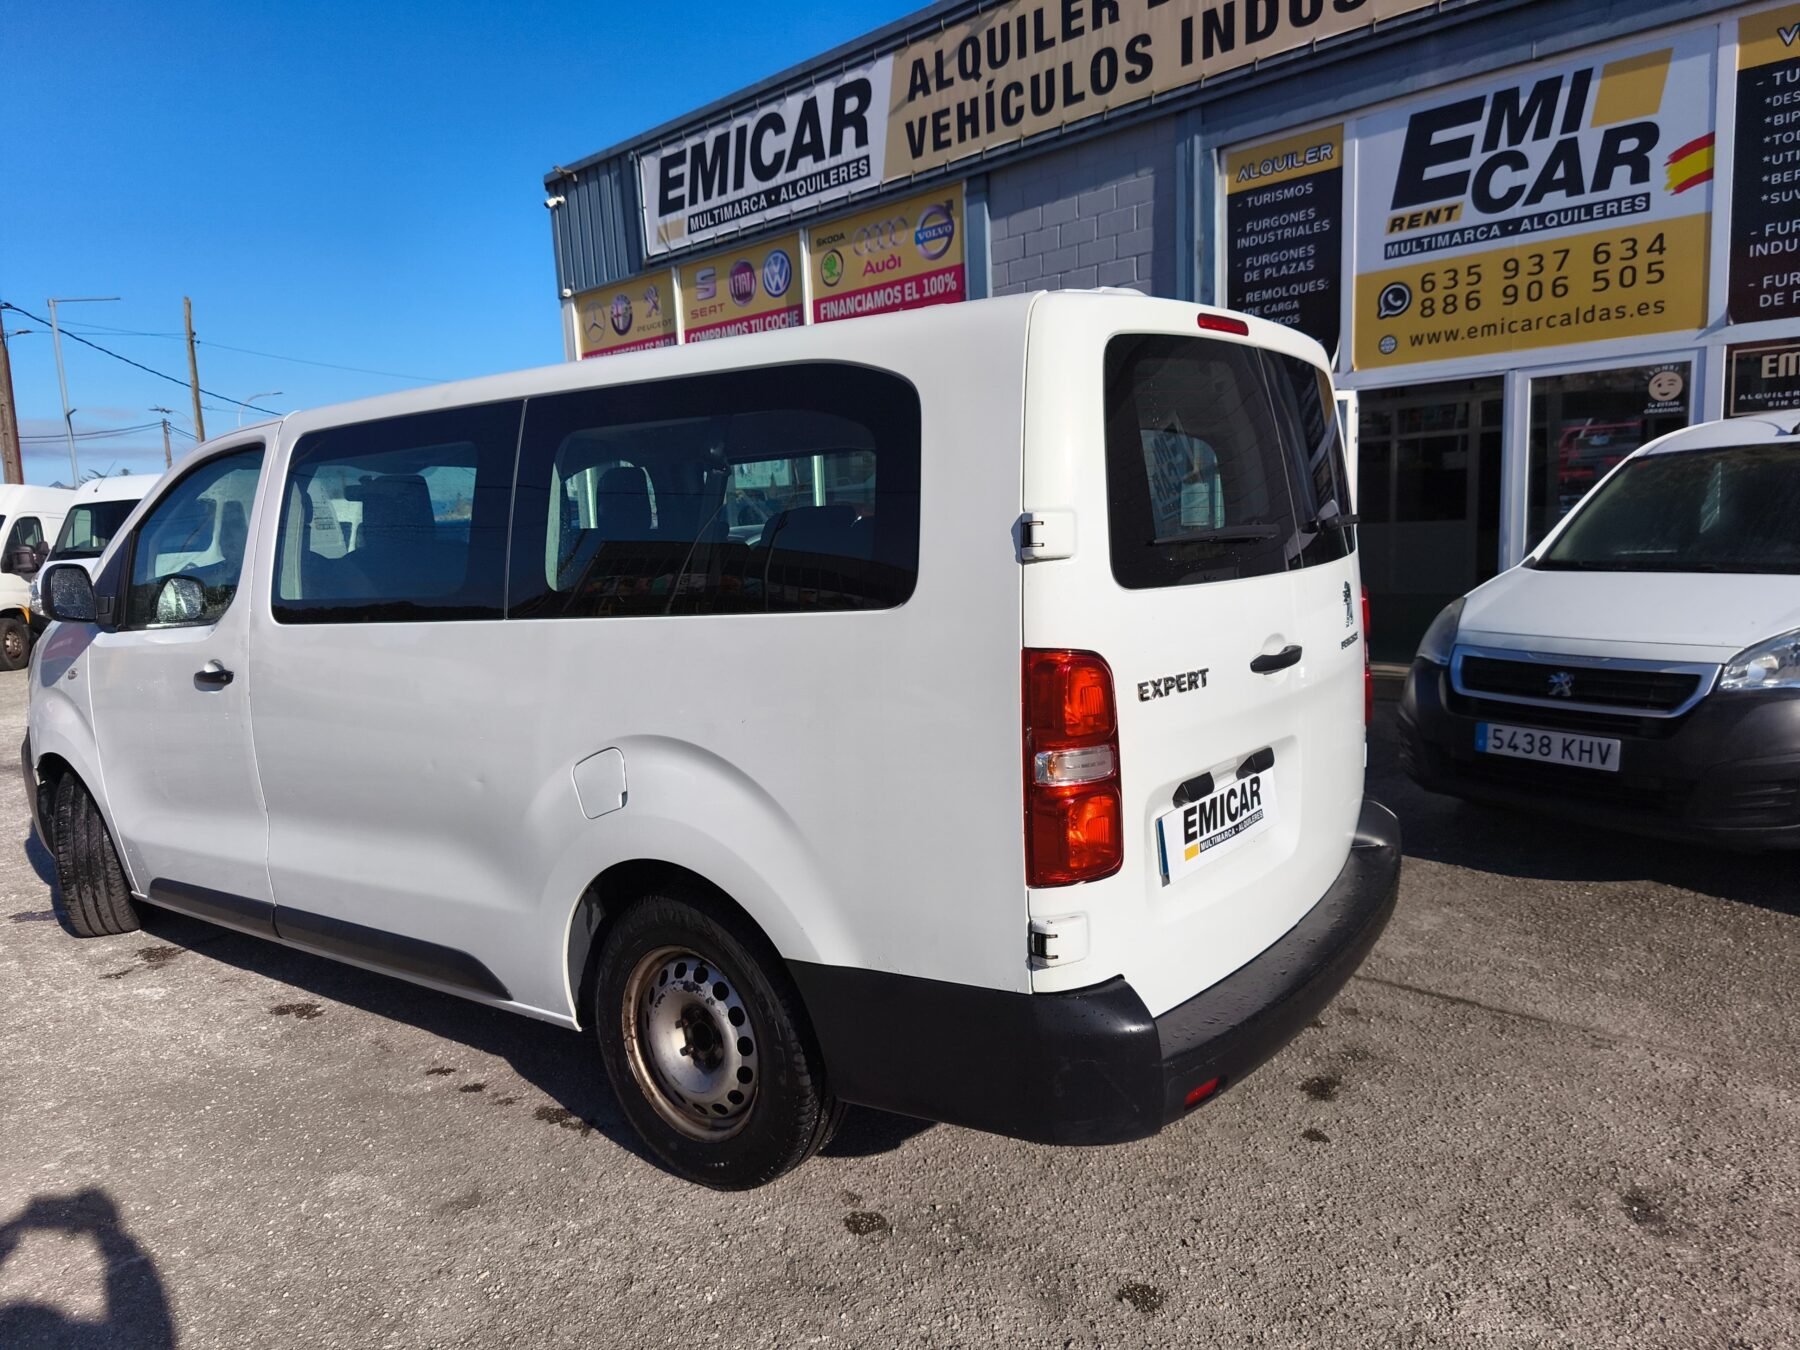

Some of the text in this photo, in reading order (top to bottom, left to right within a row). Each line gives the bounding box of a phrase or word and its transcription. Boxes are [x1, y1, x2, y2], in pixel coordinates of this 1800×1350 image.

[908, 0, 1120, 101] ALQUILER
[905, 0, 1367, 159] VEHÍCULOS INDU
[658, 77, 872, 218] EMICAR
[1390, 67, 1594, 210] EMI
[1236, 143, 1334, 183] ALQUILER
[1471, 121, 1660, 215] CAR
[689, 160, 869, 233] MULTIMARCA ALQUILERES
[1246, 182, 1314, 206] TURISMOS
[917, 224, 952, 241] VOLVO
[1236, 219, 1331, 249] INDUSTRIALES
[1245, 207, 1316, 233] FURGONES
[1386, 196, 1648, 258] MULTIMARCA ALQUILERES
[1389, 204, 1460, 233] RENT
[862, 254, 902, 277] Audi
[1244, 259, 1315, 283] DE PLAZAS
[1245, 244, 1316, 268] FURGONES
[1420, 232, 1667, 294] 635 937 634
[734, 271, 751, 296] FIAT
[820, 272, 957, 320] FINANCIAMOS EL 100%
[1420, 260, 1665, 319] 886 906 505
[1759, 292, 1785, 307] DE
[690, 302, 725, 319] SEAT
[765, 310, 800, 331] COCHE
[1263, 300, 1300, 314] CARGA
[1409, 299, 1666, 347] www.emicarcaldas.es
[636, 319, 673, 333] PEUGEOT
[1137, 668, 1209, 702] EXPERT
[1492, 728, 1611, 765] 5438 KHV
[1183, 776, 1262, 845] EMICAR
[1200, 827, 1236, 851] MULTIMARCA
